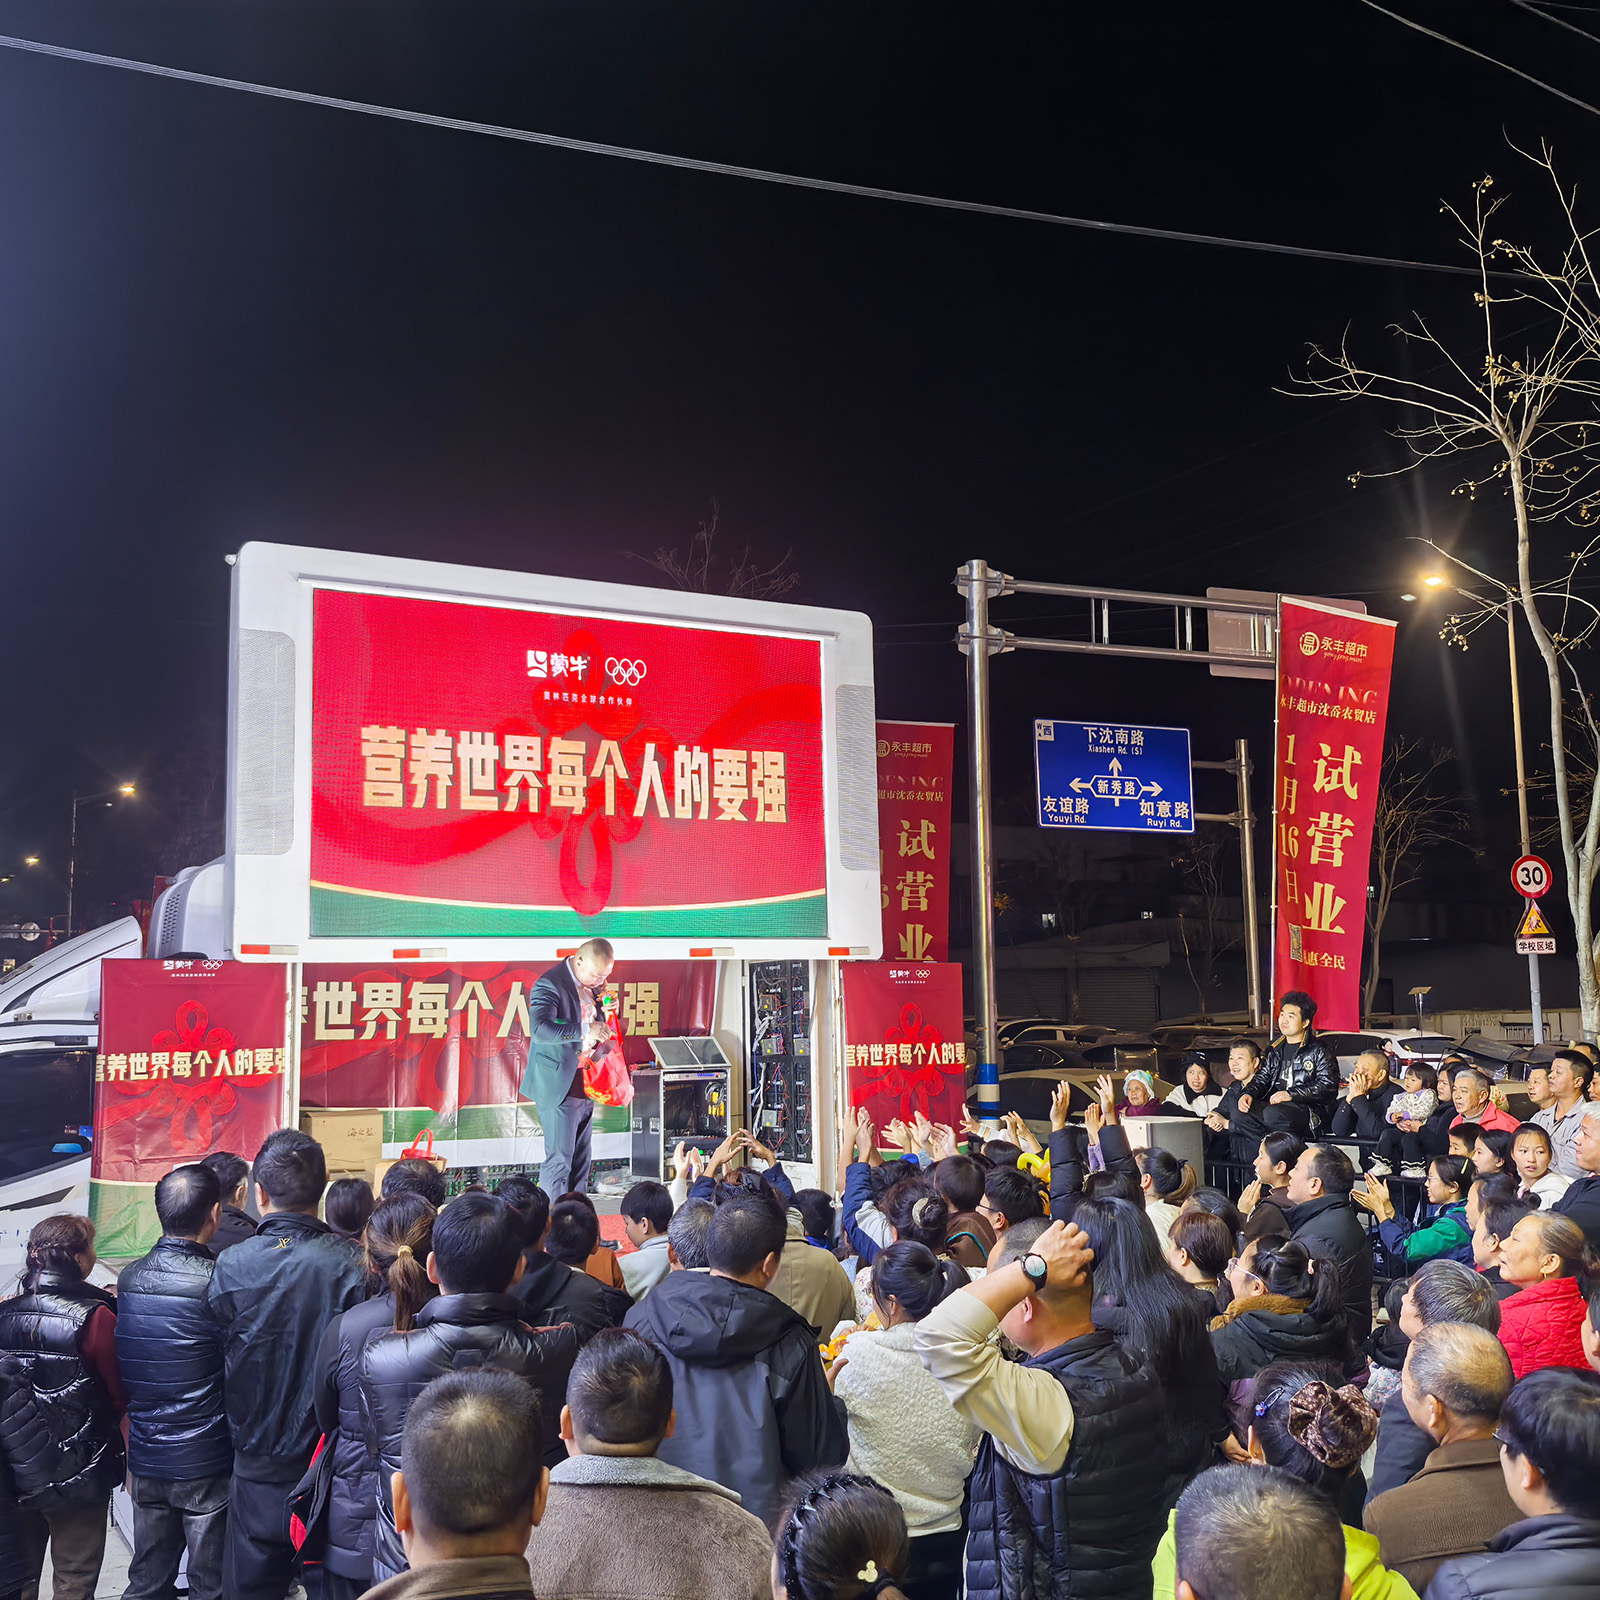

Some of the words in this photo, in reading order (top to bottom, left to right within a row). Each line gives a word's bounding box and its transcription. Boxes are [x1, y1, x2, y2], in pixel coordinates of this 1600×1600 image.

[1321, 636, 1368, 657] 永丰超市
[550, 652, 588, 681] 蒙牛
[543, 690, 633, 706] 奥林匹克全球合作伙伴
[1083, 726, 1145, 746] 下沈南路
[891, 741, 932, 753] 永丰超市
[1088, 744, 1115, 754] Xiashen
[1118, 746, 1127, 754] Rd.
[1131, 747, 1143, 755] (S)
[361, 724, 788, 823] 营养世界每个人的要强
[1097, 780, 1136, 796] 新秀路
[1043, 796, 1090, 815] 友谊路
[1139, 799, 1190, 819] 如意路
[1048, 814, 1073, 825] Youyi
[1075, 815, 1087, 824] Rd.
[1147, 819, 1167, 829] Ruyi
[1170, 820, 1183, 828] Rd.
[1301, 742, 1363, 934] 试营业
[1520, 866, 1544, 886] 30
[895, 819, 937, 961] 试营业
[1518, 941, 1554, 952] 学校区域
